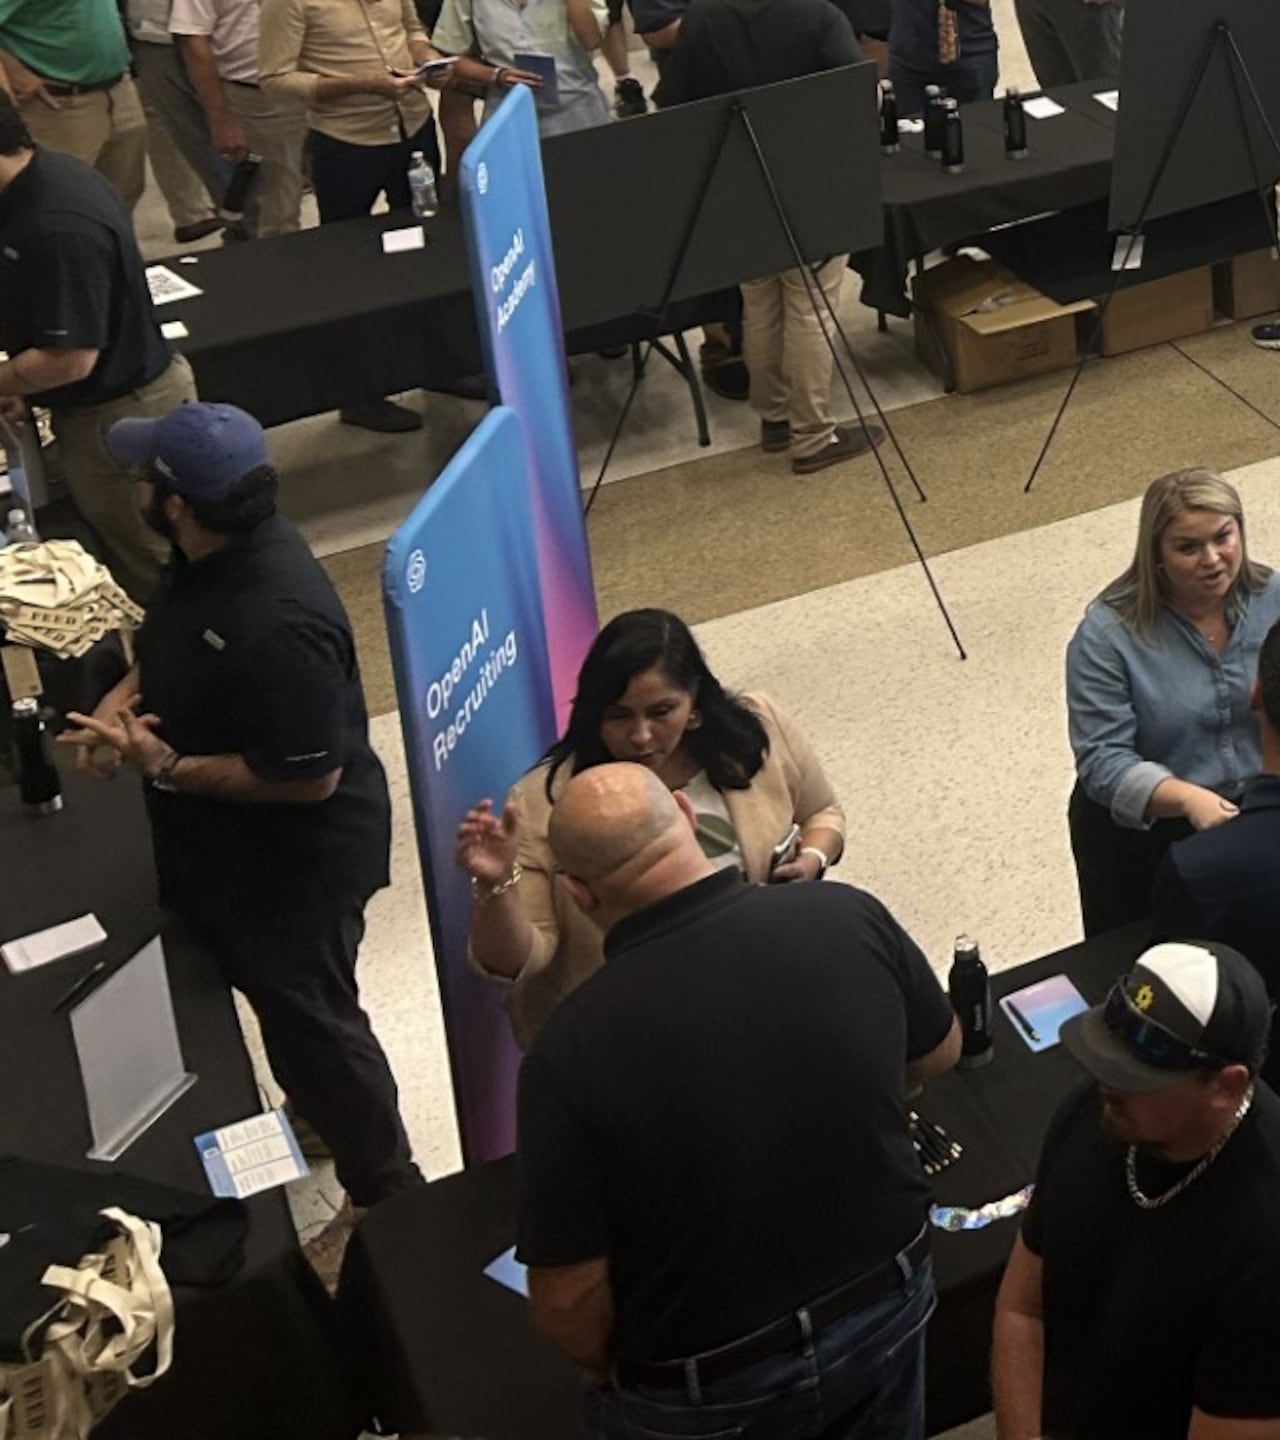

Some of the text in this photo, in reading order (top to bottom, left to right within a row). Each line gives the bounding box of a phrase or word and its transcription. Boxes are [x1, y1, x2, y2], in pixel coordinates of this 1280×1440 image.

[491, 227, 524, 293] OpenAI
[497, 258, 536, 335] Academy
[31, 611, 77, 626] FEED
[426, 608, 490, 720] OpenAI
[433, 630, 518, 772] Recruiting
